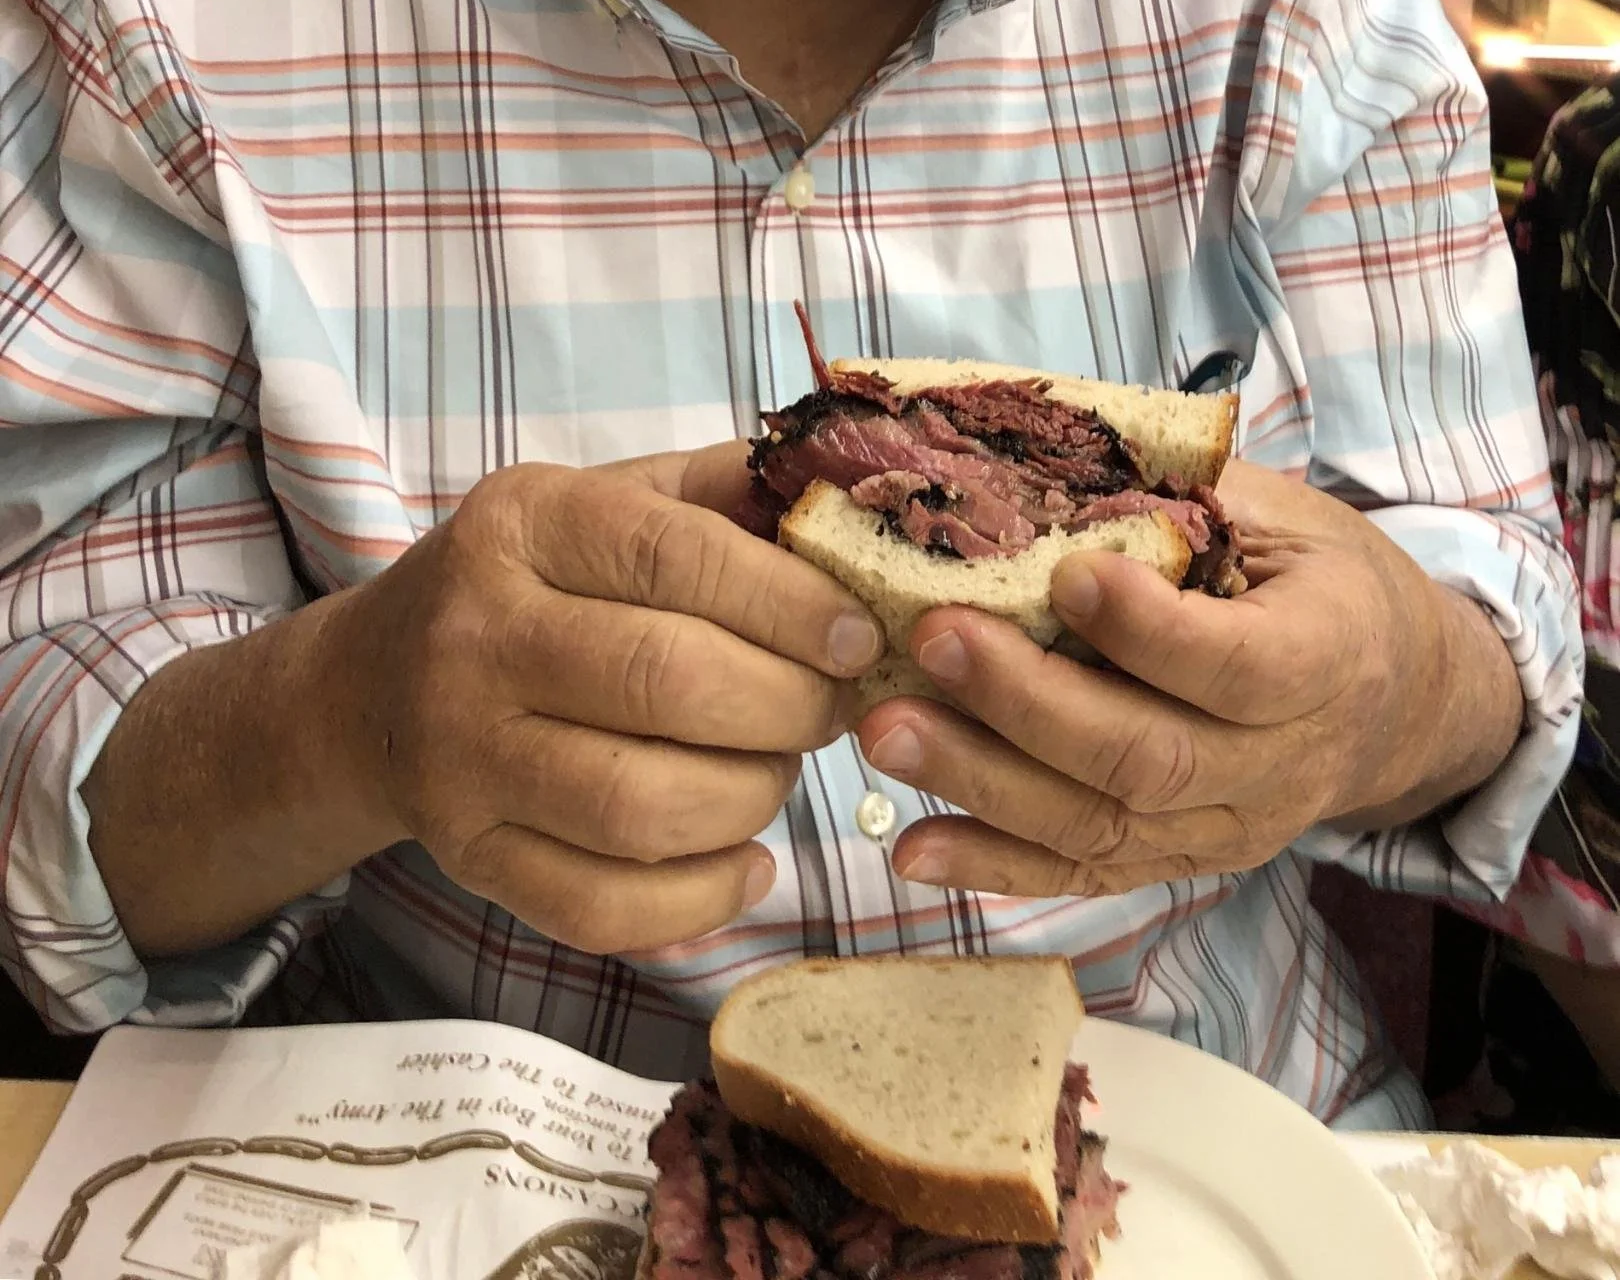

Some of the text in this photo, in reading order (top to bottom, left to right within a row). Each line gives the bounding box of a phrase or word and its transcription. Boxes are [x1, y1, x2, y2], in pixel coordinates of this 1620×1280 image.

[396, 1052, 491, 1075] Cashier
[498, 1058, 543, 1085] The
[552, 1076, 577, 1100] To
[400, 1098, 446, 1121] The
[456, 1097, 483, 1120] in
[487, 1095, 537, 1130] Boy
[543, 1120, 596, 1154] Your
[484, 1162, 651, 1220] CCASIONS
